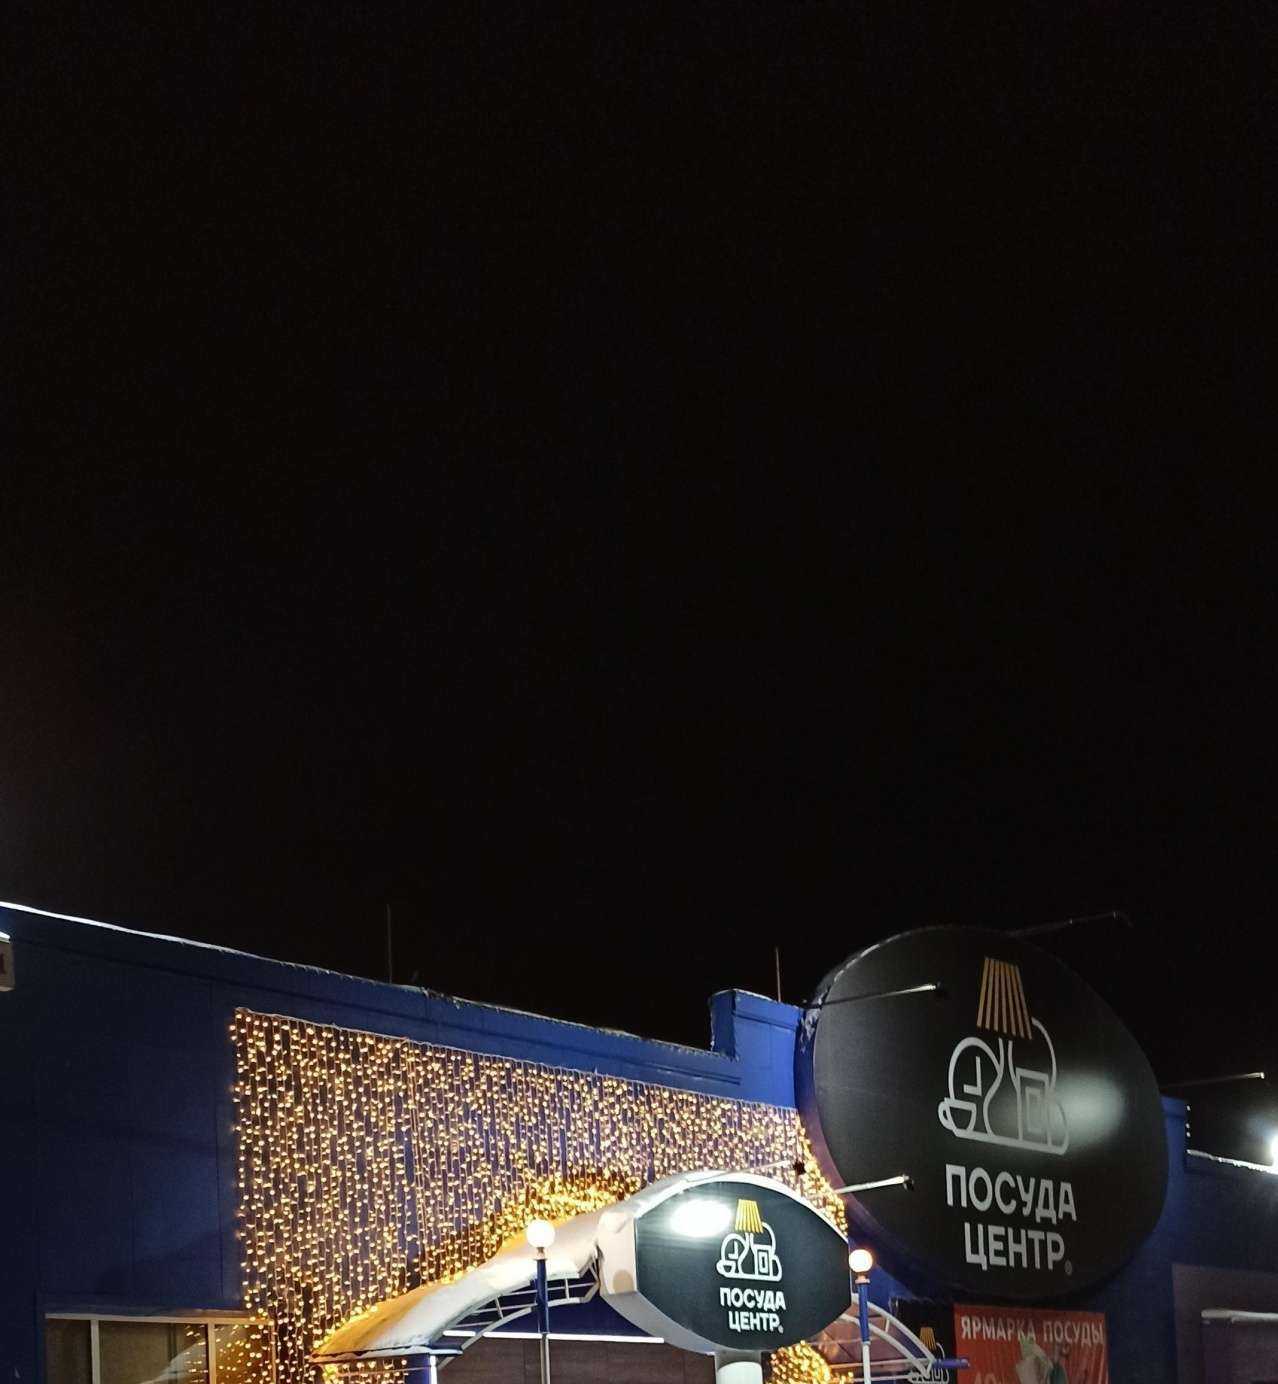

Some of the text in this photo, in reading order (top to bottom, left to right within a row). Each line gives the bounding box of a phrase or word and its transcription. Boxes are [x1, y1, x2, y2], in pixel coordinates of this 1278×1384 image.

[945, 1163, 1077, 1225] ПОСУДА
[719, 1287, 787, 1312] ПОСУДА
[961, 1314, 1105, 1347] ЯРМАРКА ПОСУДЫ
